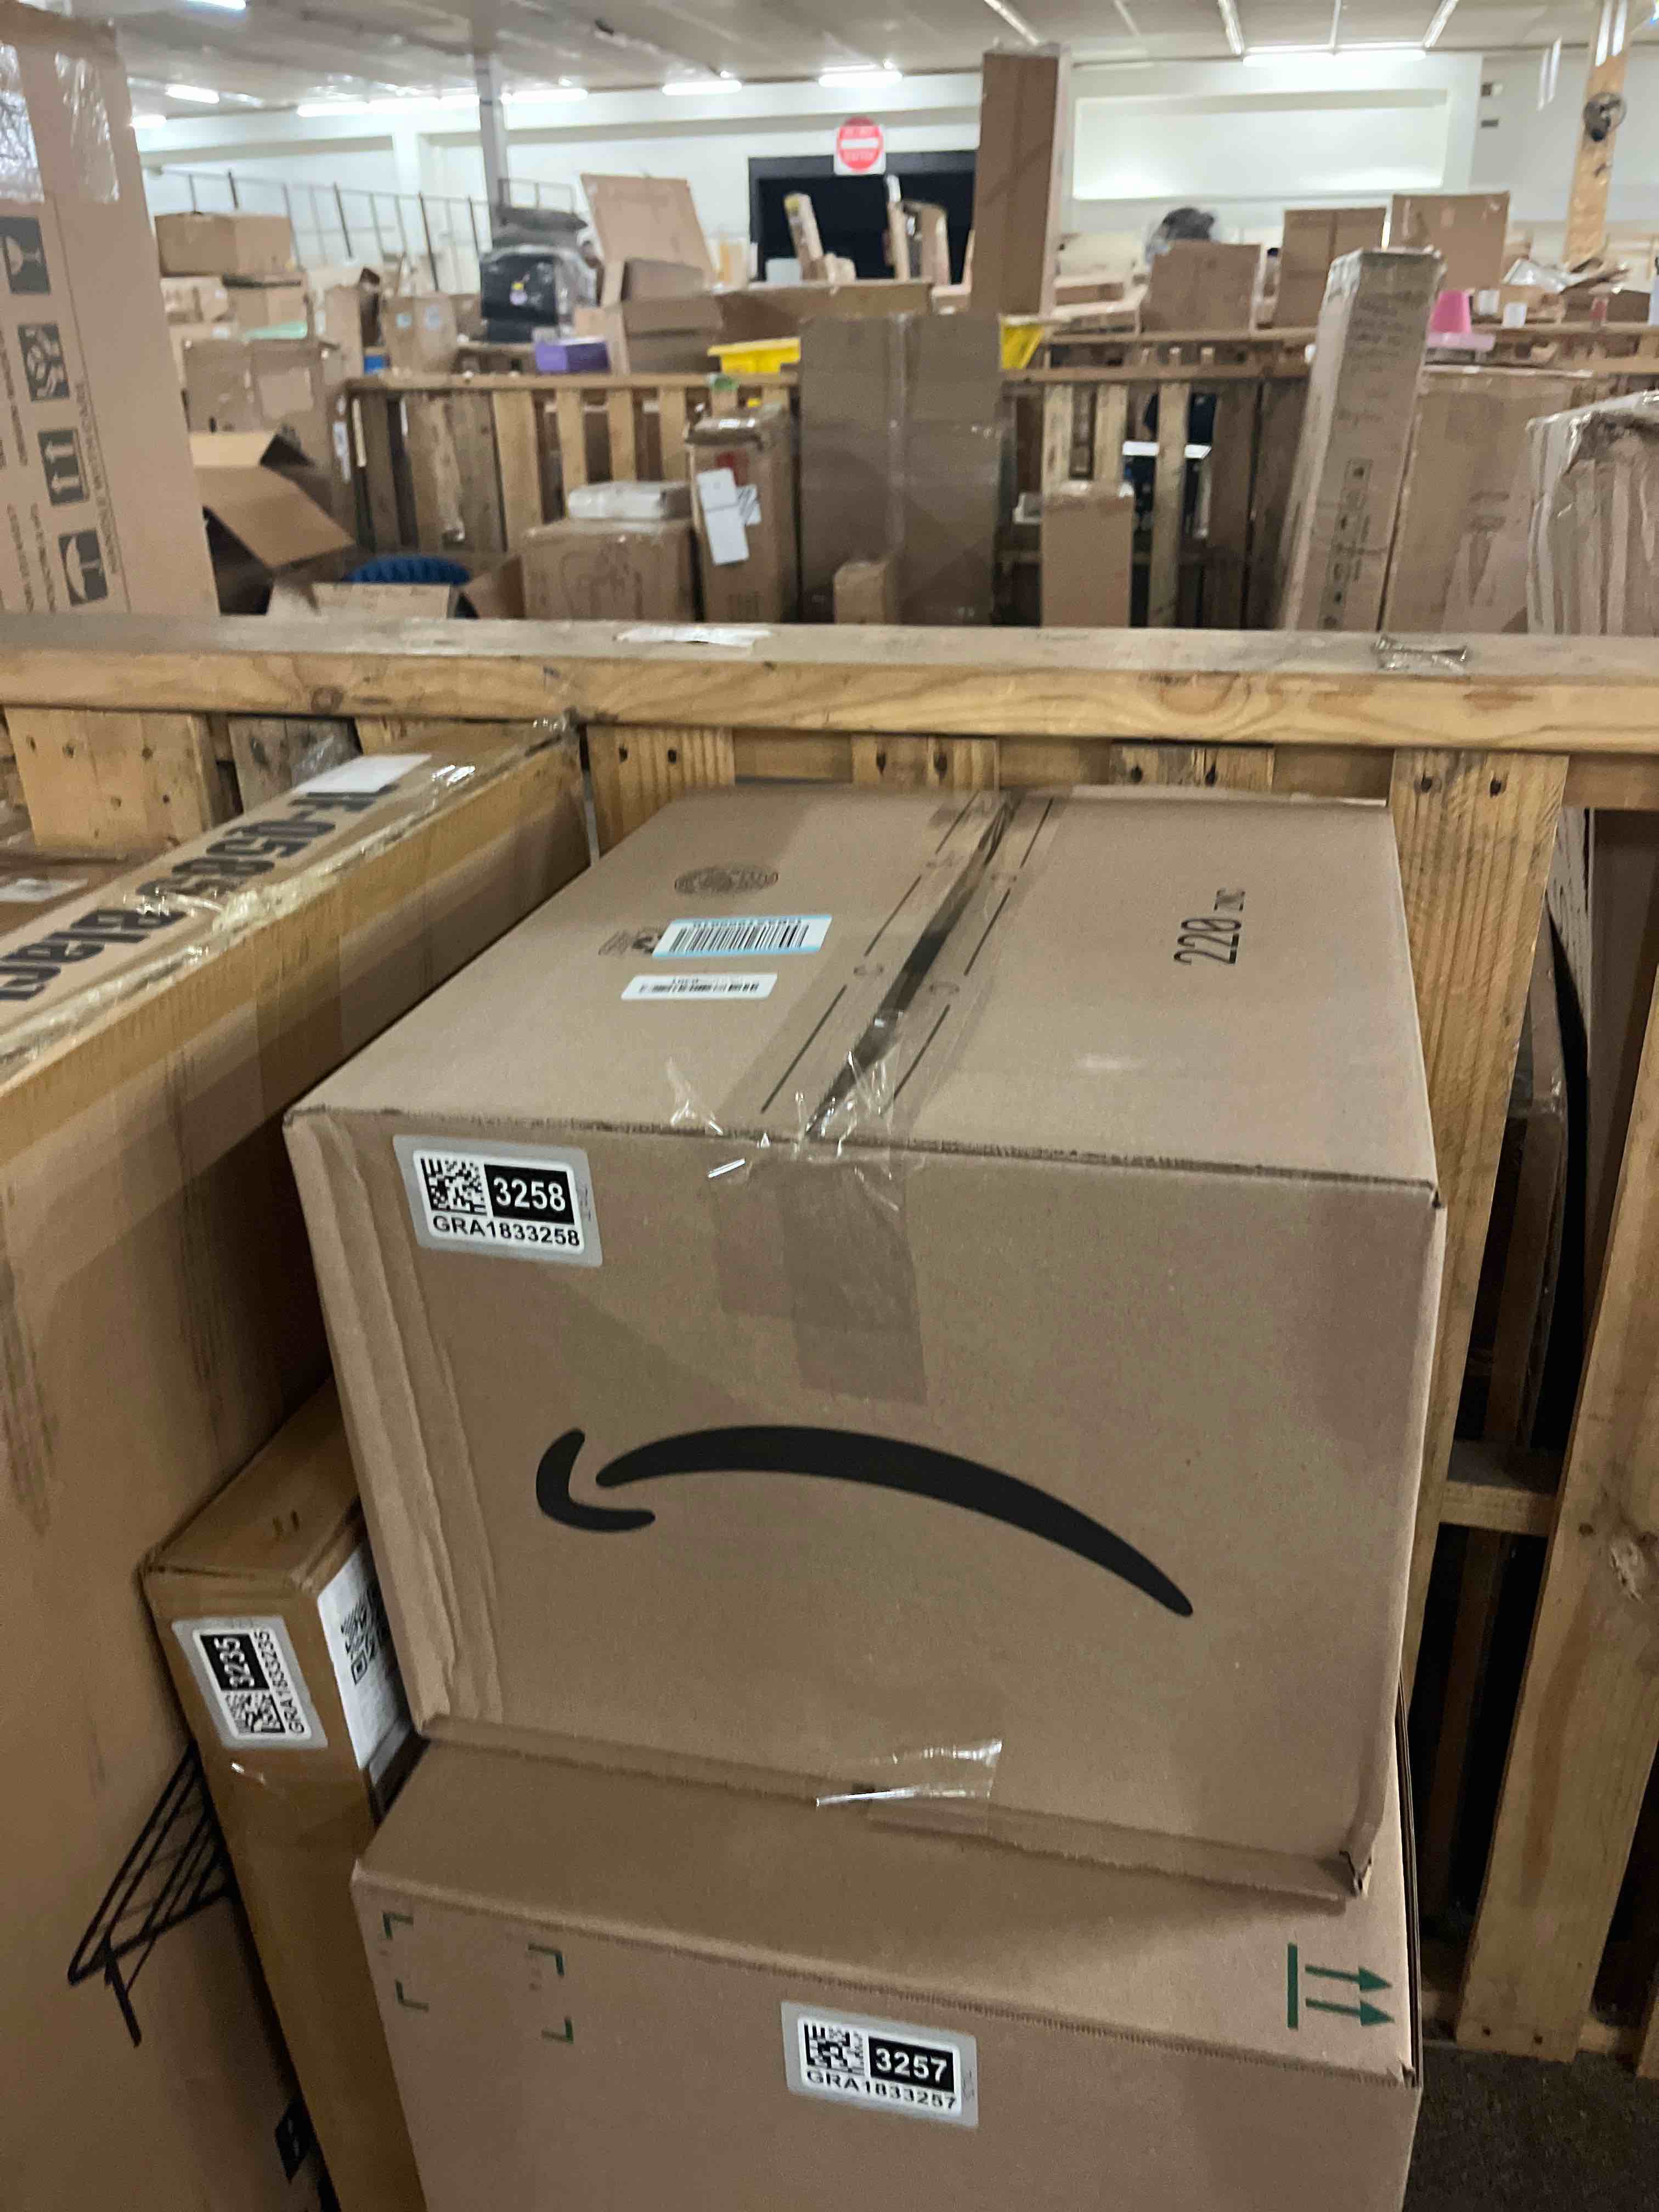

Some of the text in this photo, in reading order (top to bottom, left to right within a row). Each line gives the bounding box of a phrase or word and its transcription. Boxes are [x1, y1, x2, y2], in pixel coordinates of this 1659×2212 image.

[493, 1176, 566, 1212] 3258
[432, 1215, 580, 1247] GRA1833258
[214, 1637, 255, 1688] 3235
[253, 1630, 305, 1735] GRA1833235
[875, 2047, 948, 2083] 3257
[806, 2069, 957, 2109] GRA1833257
